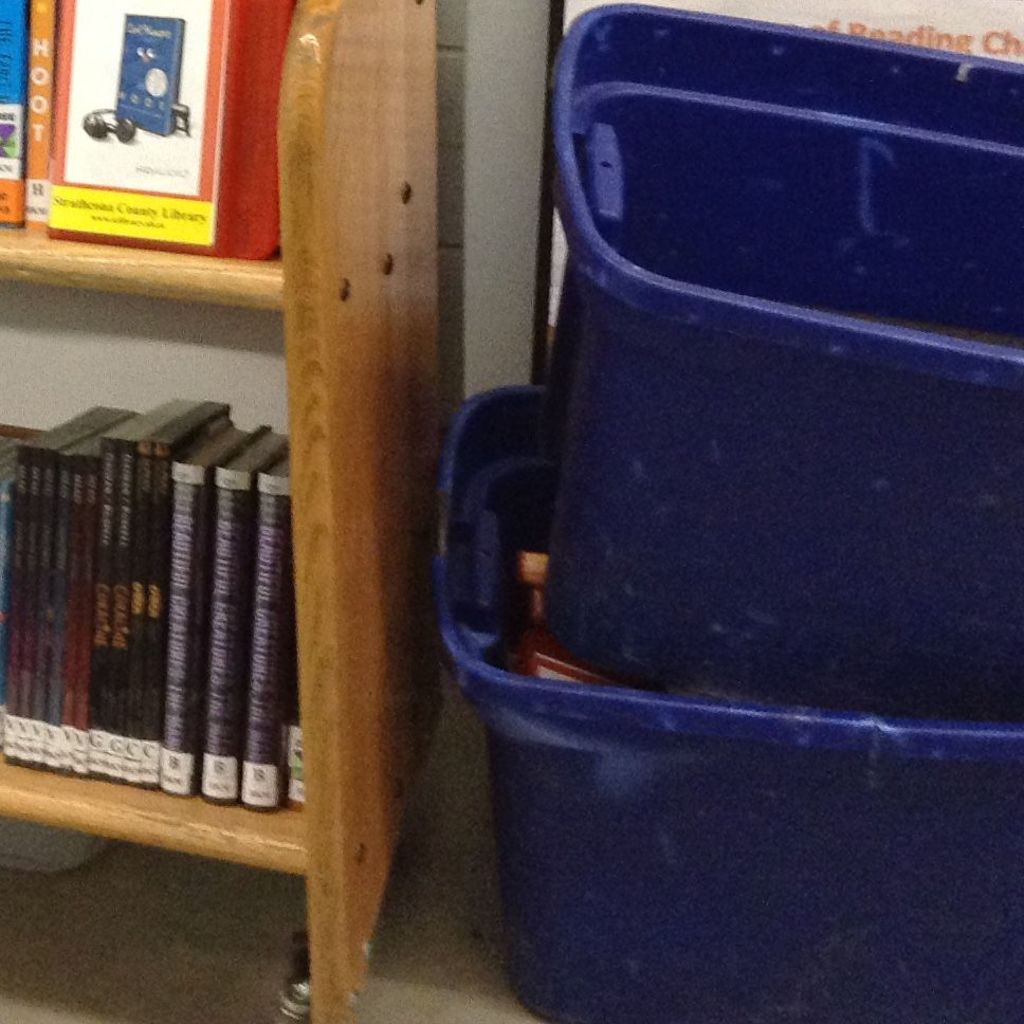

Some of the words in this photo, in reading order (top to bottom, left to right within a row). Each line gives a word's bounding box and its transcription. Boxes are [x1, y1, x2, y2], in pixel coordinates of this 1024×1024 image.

[983, 30, 1024, 56] Ch
[116, 201, 157, 219] County
[161, 207, 207, 225] Library
